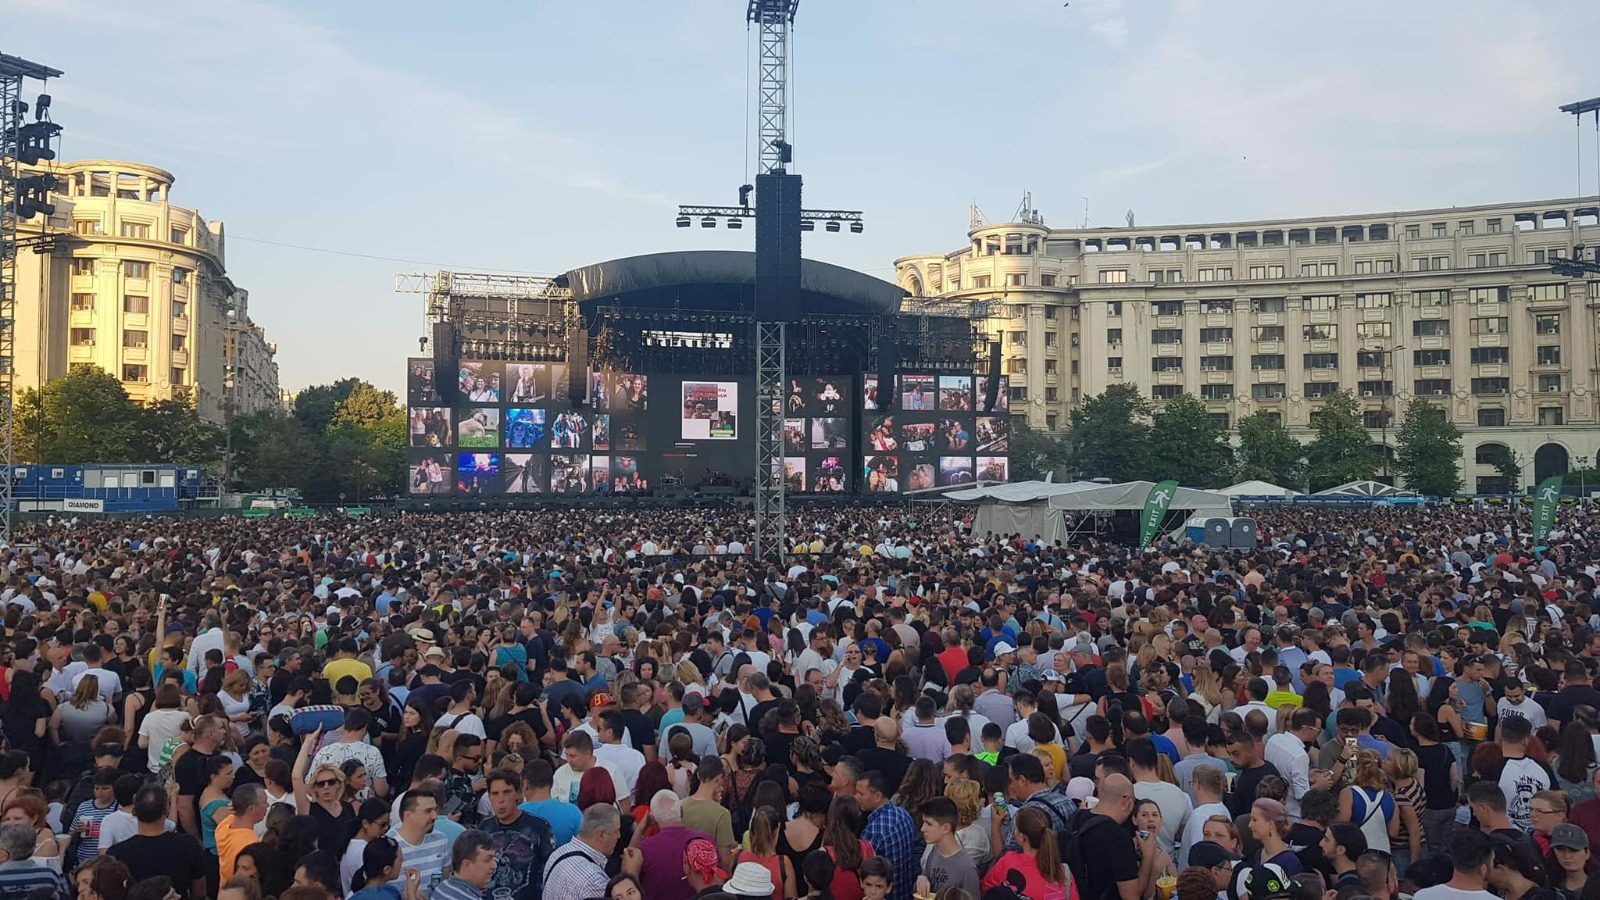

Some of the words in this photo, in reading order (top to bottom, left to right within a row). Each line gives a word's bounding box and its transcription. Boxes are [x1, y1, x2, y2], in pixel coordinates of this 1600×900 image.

[68, 501, 99, 509] DIAMOND
[1541, 505, 1550, 521] EXIT
[1148, 509, 1160, 528] EXIT
